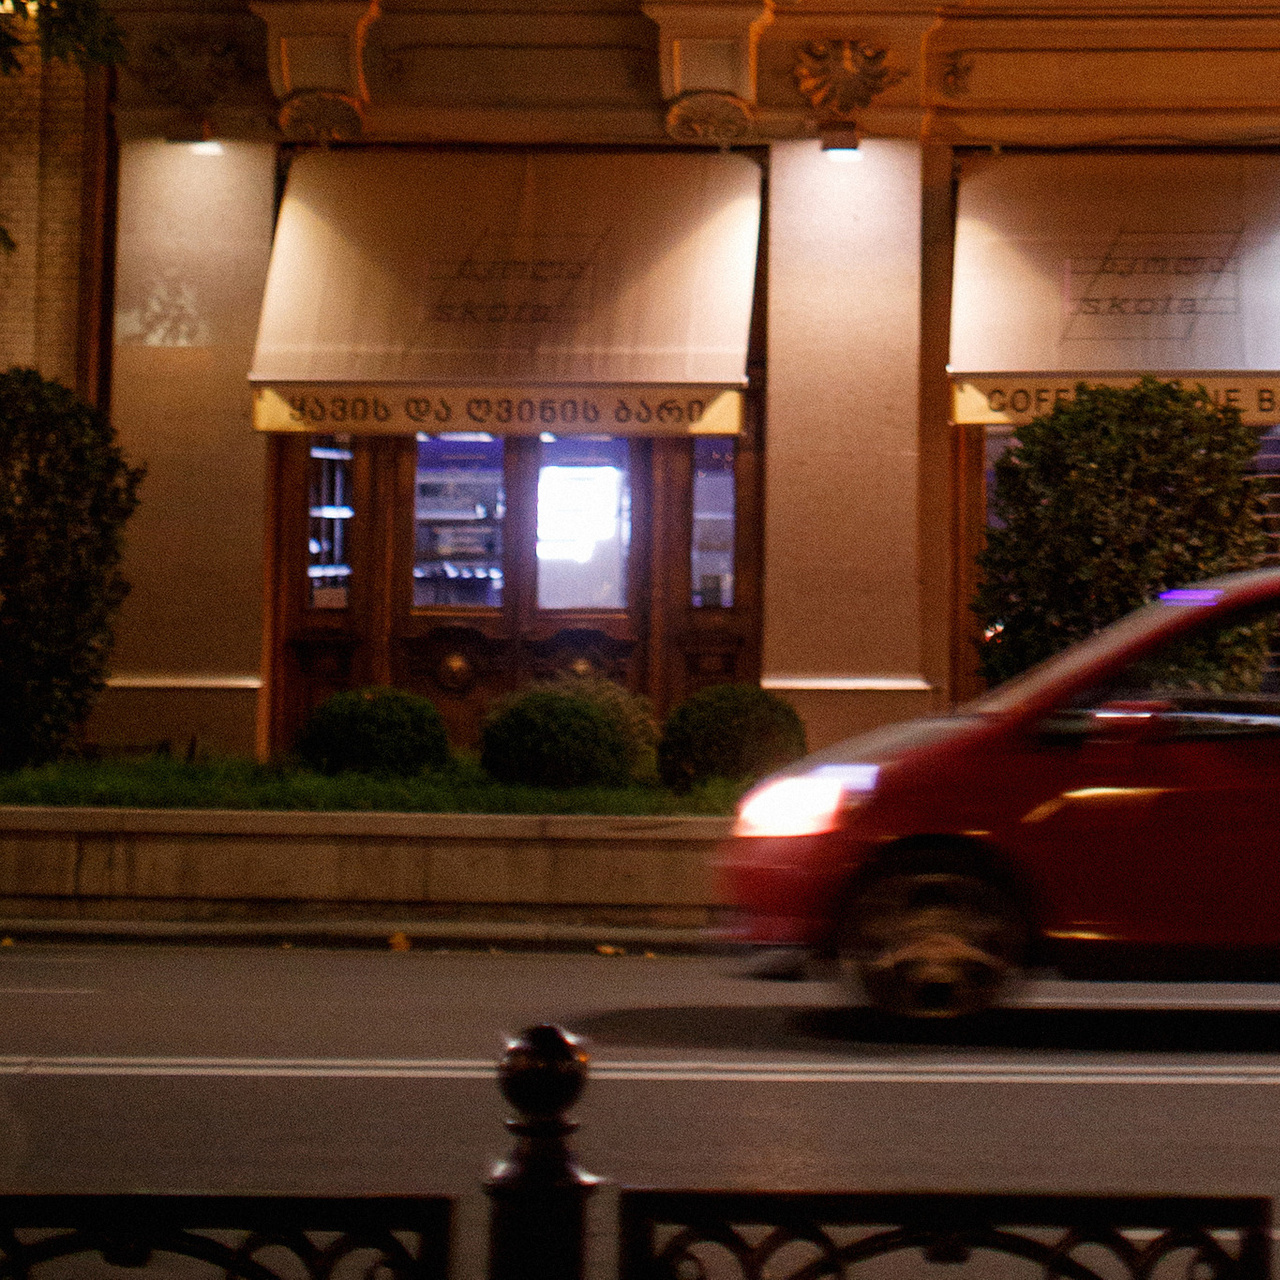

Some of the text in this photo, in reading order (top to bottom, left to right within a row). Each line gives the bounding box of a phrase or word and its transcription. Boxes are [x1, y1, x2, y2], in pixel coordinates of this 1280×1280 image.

[403, 395, 452, 424] და
[465, 395, 600, 424] ღვინის
[613, 395, 705, 424] ბარი
